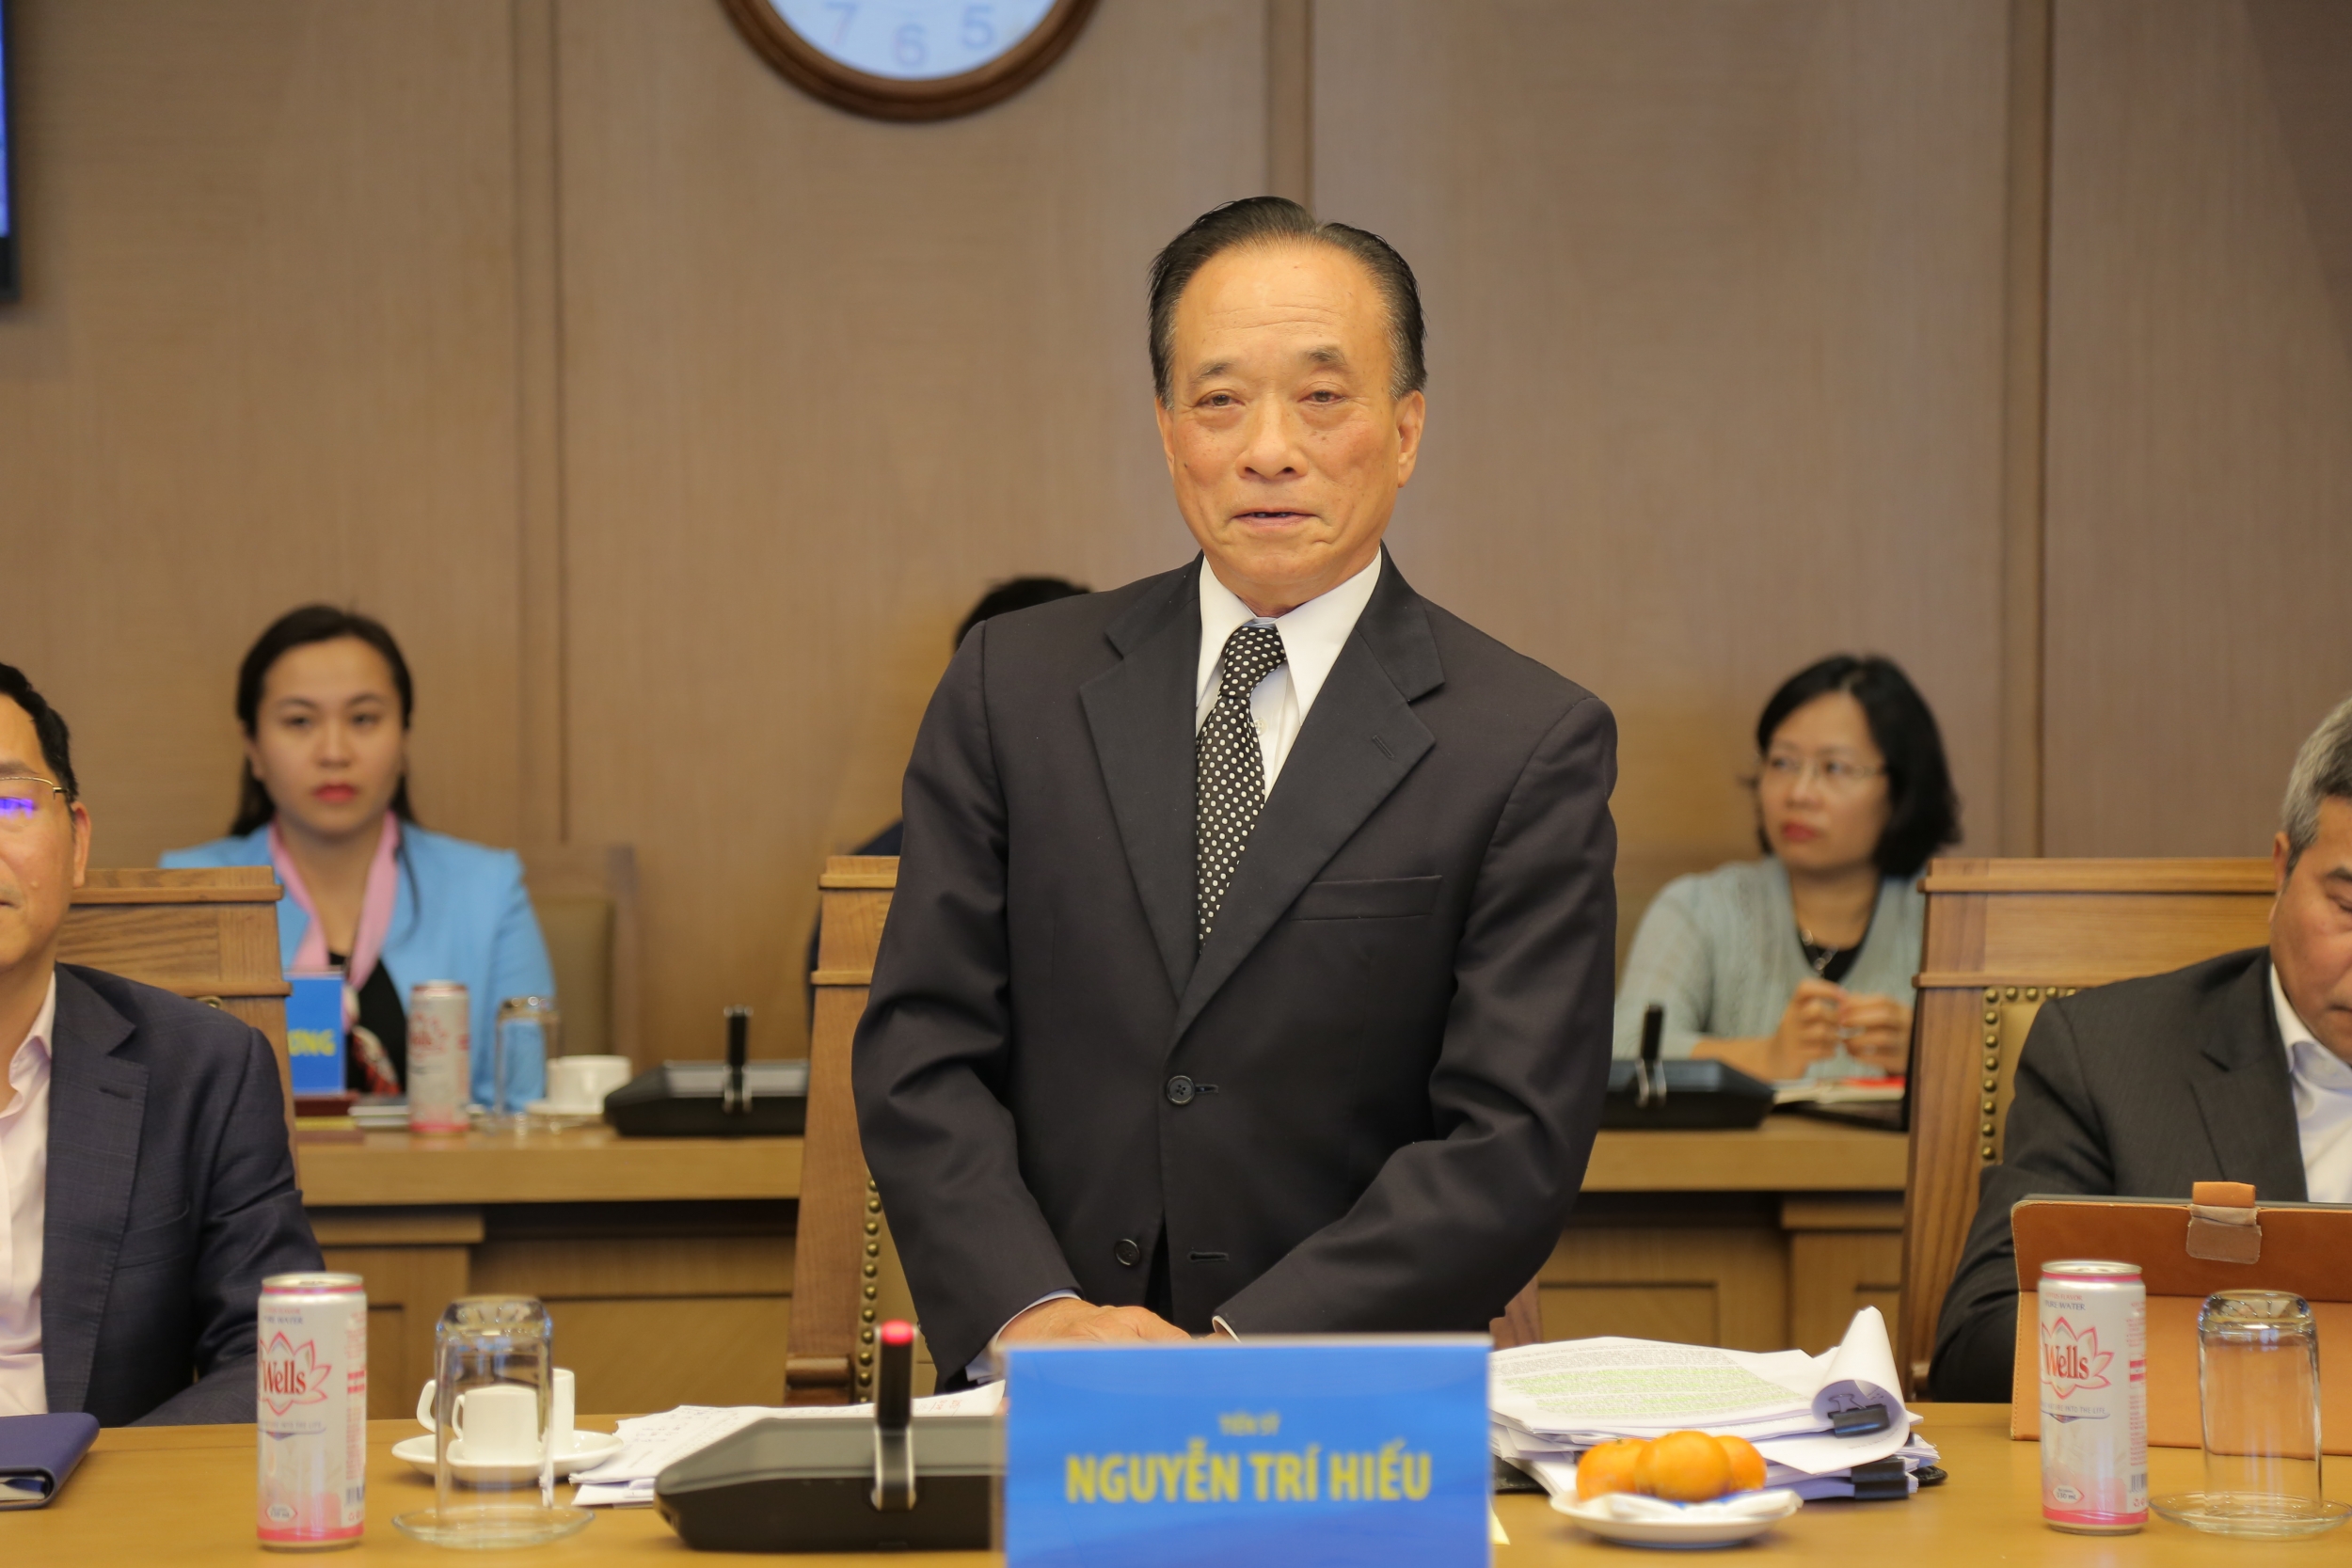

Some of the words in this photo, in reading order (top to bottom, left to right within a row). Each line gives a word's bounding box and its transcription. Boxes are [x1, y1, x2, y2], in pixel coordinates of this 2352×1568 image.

[821, 0, 859, 45] 7
[892, 22, 930, 67] 6
[961, 4, 995, 49] 5
[2059, 1302, 2086, 1310] WATER
[262, 1359, 307, 1396] Wells
[2045, 1343, 2090, 1380] Wells
[1066, 1437, 1239, 1502] NGUYỄN
[1248, 1443, 1322, 1501] TRÍ
[1328, 1437, 1432, 1500] HIẾU
